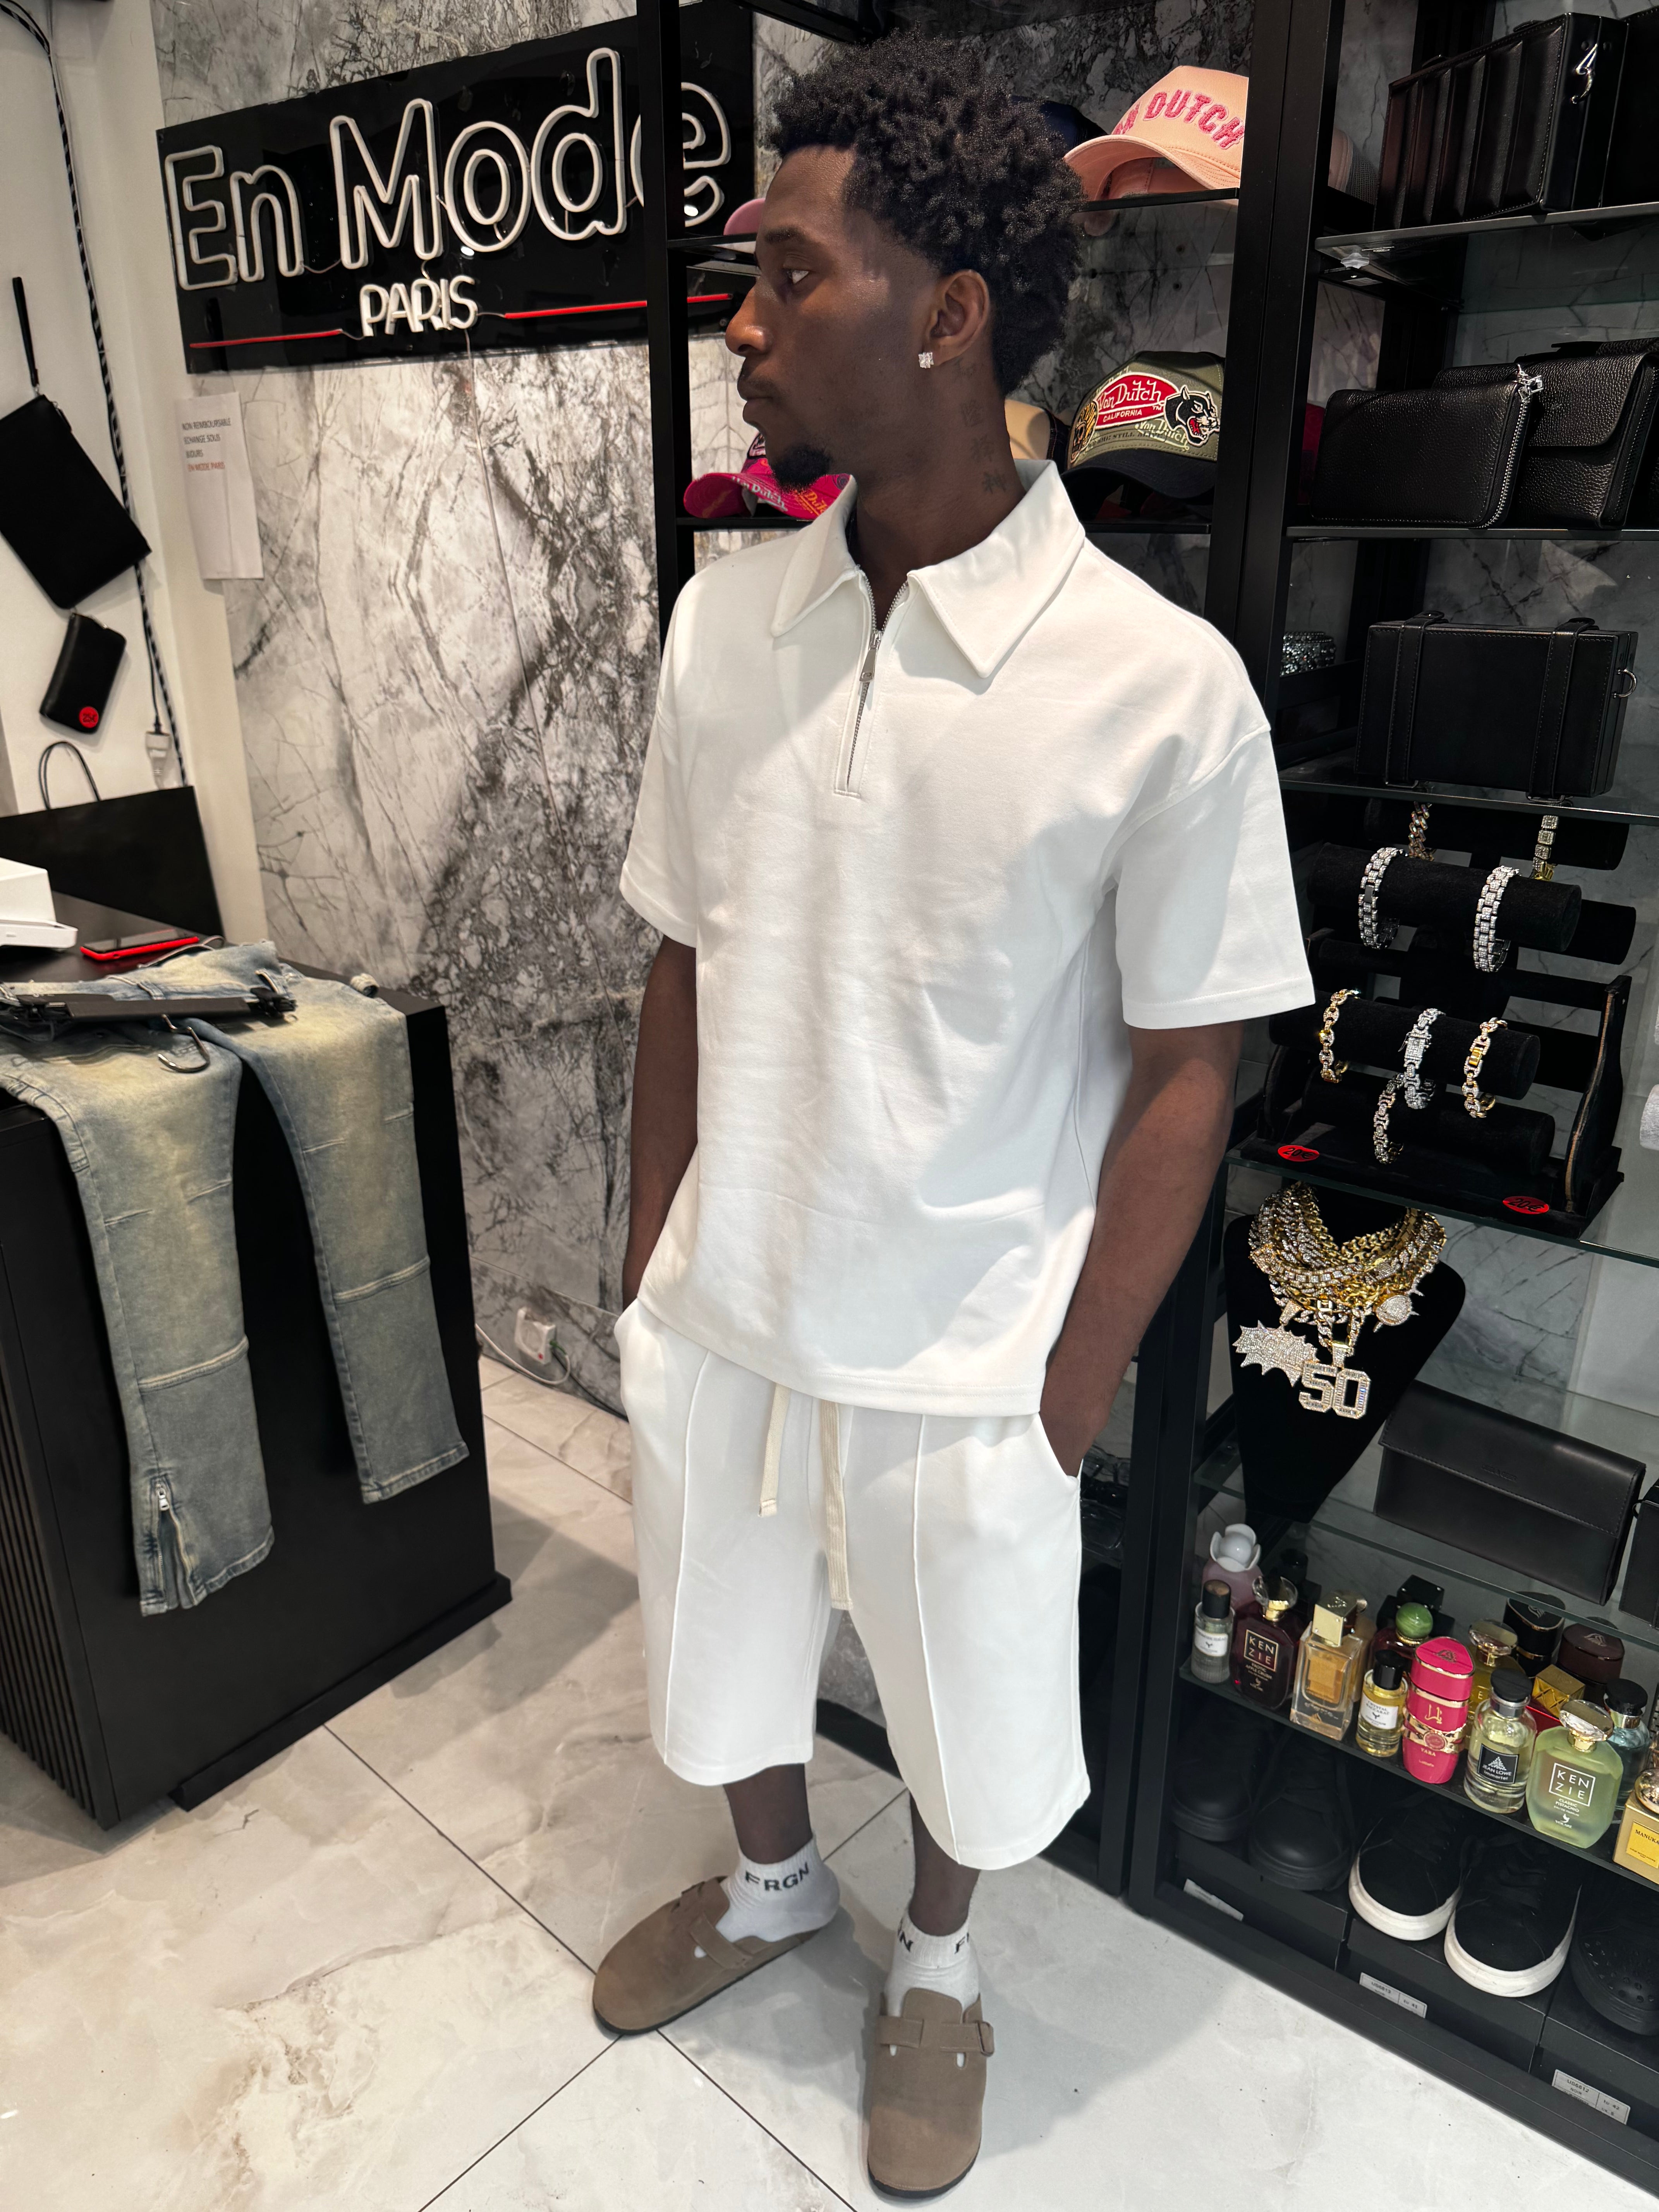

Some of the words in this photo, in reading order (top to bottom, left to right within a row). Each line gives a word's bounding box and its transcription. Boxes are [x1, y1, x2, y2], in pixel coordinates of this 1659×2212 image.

[1143, 89, 1245, 150] DUTCH
[165, 144, 305, 290] En
[360, 274, 479, 337] PARIS
[1106, 380, 1162, 406] Dutch
[1103, 409, 1142, 422] CALIFORNIA
[1282, 1147, 1314, 1160] 20€
[1508, 1198, 1544, 1212] 20€
[1298, 1360, 1372, 1420] 50
[1249, 1636, 1274, 1655] KEN
[1248, 1647, 1271, 1665] ZIE
[1420, 1747, 1436, 1757] YARA
[1482, 1764, 1495, 1773] JEAN
[1557, 1770, 1589, 1789] KEN
[1555, 1782, 1585, 1800] ZIE
[1555, 1801, 1580, 1813] PISTACHIO
[1558, 1798, 1578, 1808] CLASSIC
[745, 1861, 809, 1891] FRGN
